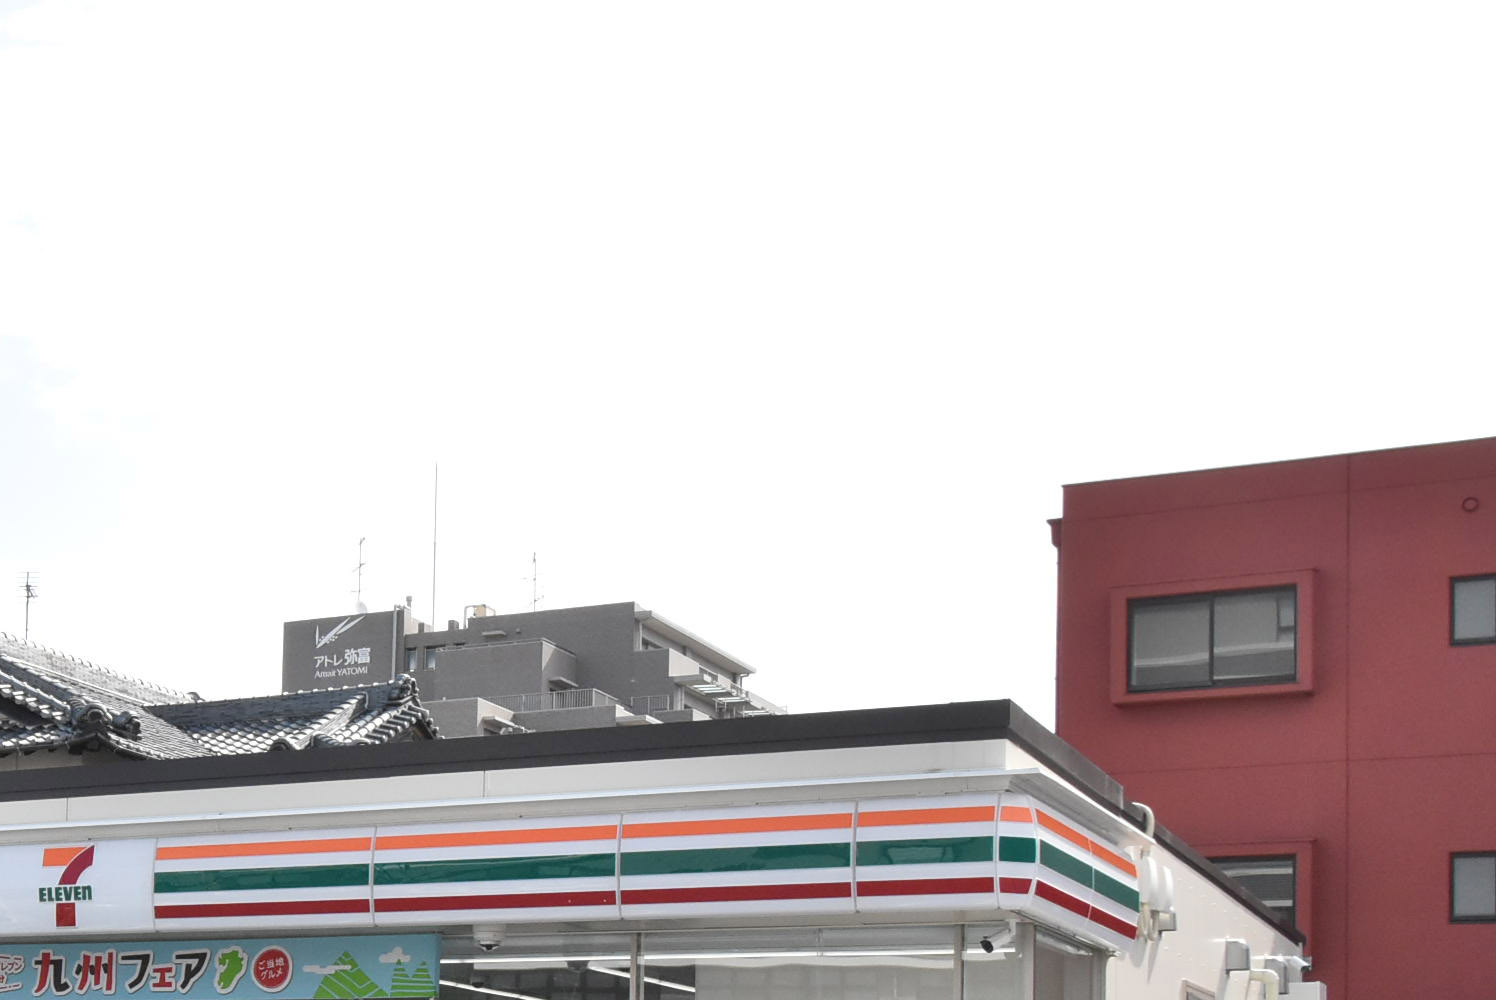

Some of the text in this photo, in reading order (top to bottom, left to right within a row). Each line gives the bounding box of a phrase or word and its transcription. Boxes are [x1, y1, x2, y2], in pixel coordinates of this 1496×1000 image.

[337, 666, 368, 676] YATOMI
[258, 957, 285, 970] ご当地
[33, 951, 208, 994] 九州フェア
[260, 967, 283, 981] グルメ
